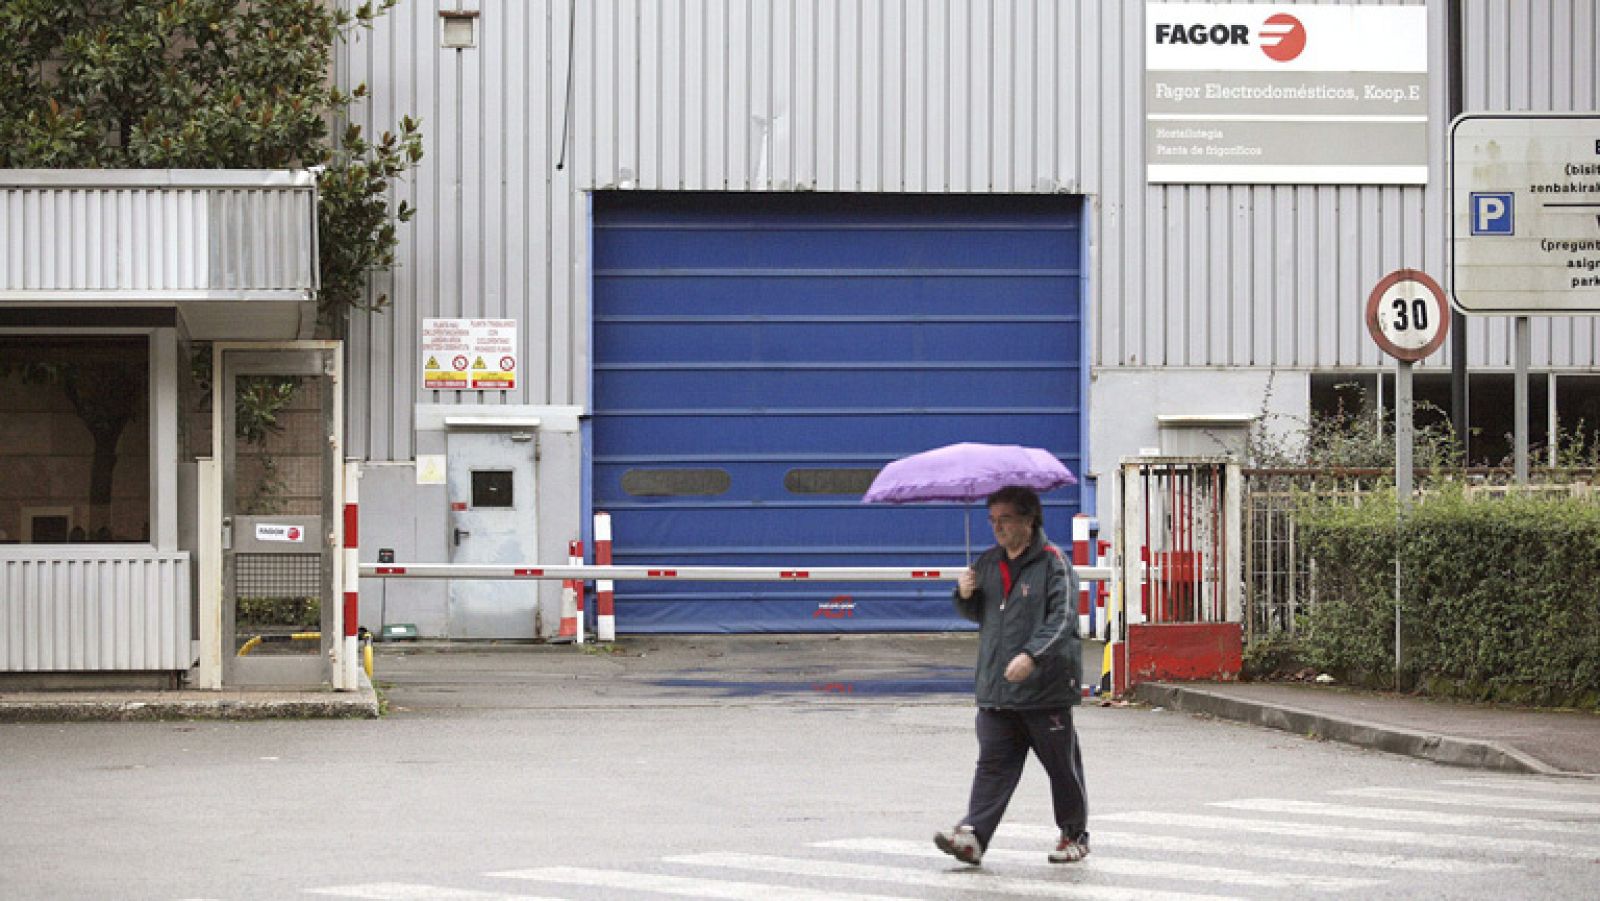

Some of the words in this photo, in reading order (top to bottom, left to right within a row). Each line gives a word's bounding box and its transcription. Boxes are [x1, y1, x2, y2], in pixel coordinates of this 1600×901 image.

[1155, 24, 1249, 45] FAGOR
[1155, 83, 1201, 102] Fagor
[1204, 82, 1359, 101] Electrodomésticos,
[1364, 84, 1420, 103] Koop.E
[1156, 145, 1188, 155] Planta
[1191, 145, 1203, 155] de
[1479, 198, 1505, 230] P
[1392, 298, 1427, 330] 30
